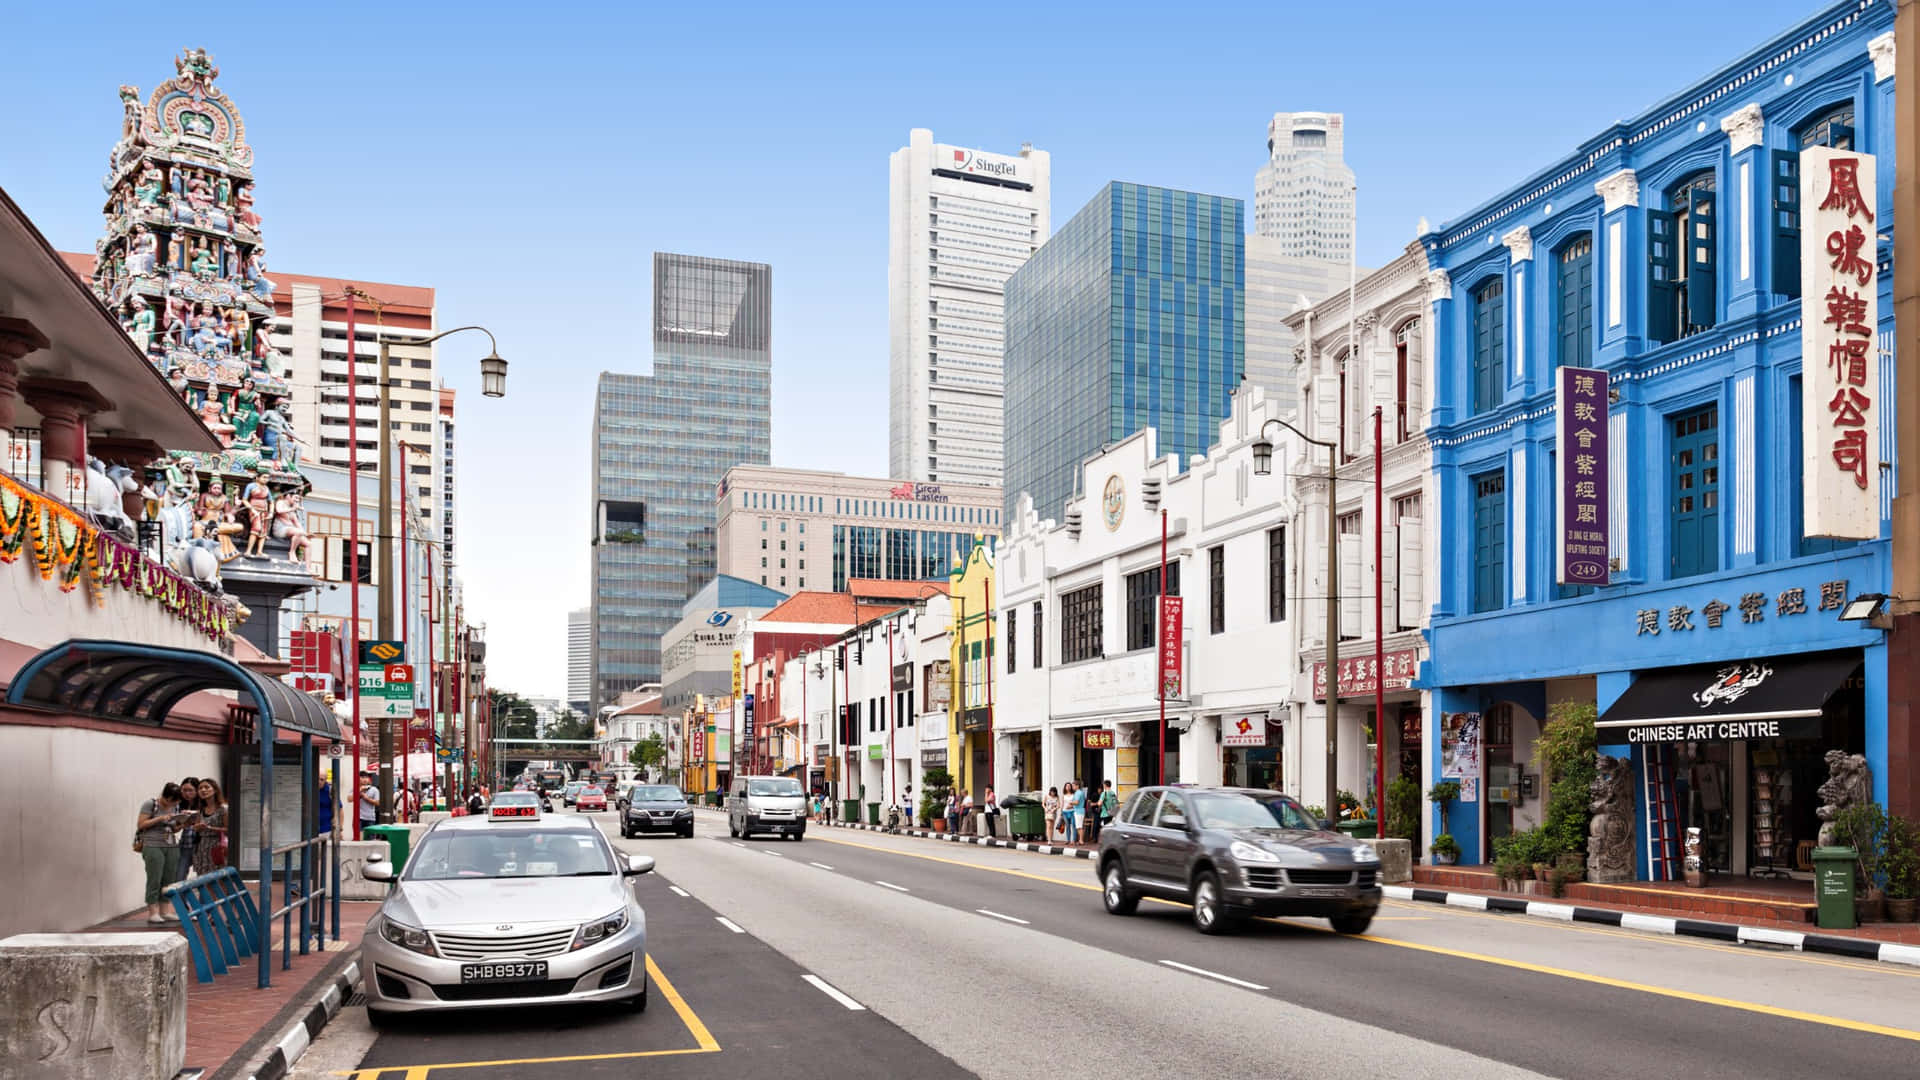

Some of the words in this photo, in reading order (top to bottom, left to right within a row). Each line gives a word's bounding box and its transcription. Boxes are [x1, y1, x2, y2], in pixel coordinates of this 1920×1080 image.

[976, 158, 1016, 176] SingTel
[1818, 158, 1874, 490] 鳳鳴鞋帽公司
[1574, 375, 1597, 524] 德教會紫經閣
[915, 483, 941, 494] Great
[915, 493, 949, 504] Eastern
[1576, 564, 1597, 576] 249
[1636, 579, 1849, 636] 德教會紫經閣
[390, 683, 408, 692] Taxi
[386, 702, 396, 715] 4
[1628, 725, 1684, 743] CHINESE
[1687, 724, 1715, 740] ART
[1718, 721, 1780, 739] CENTRE
[463, 963, 546, 979] SHB8937P
